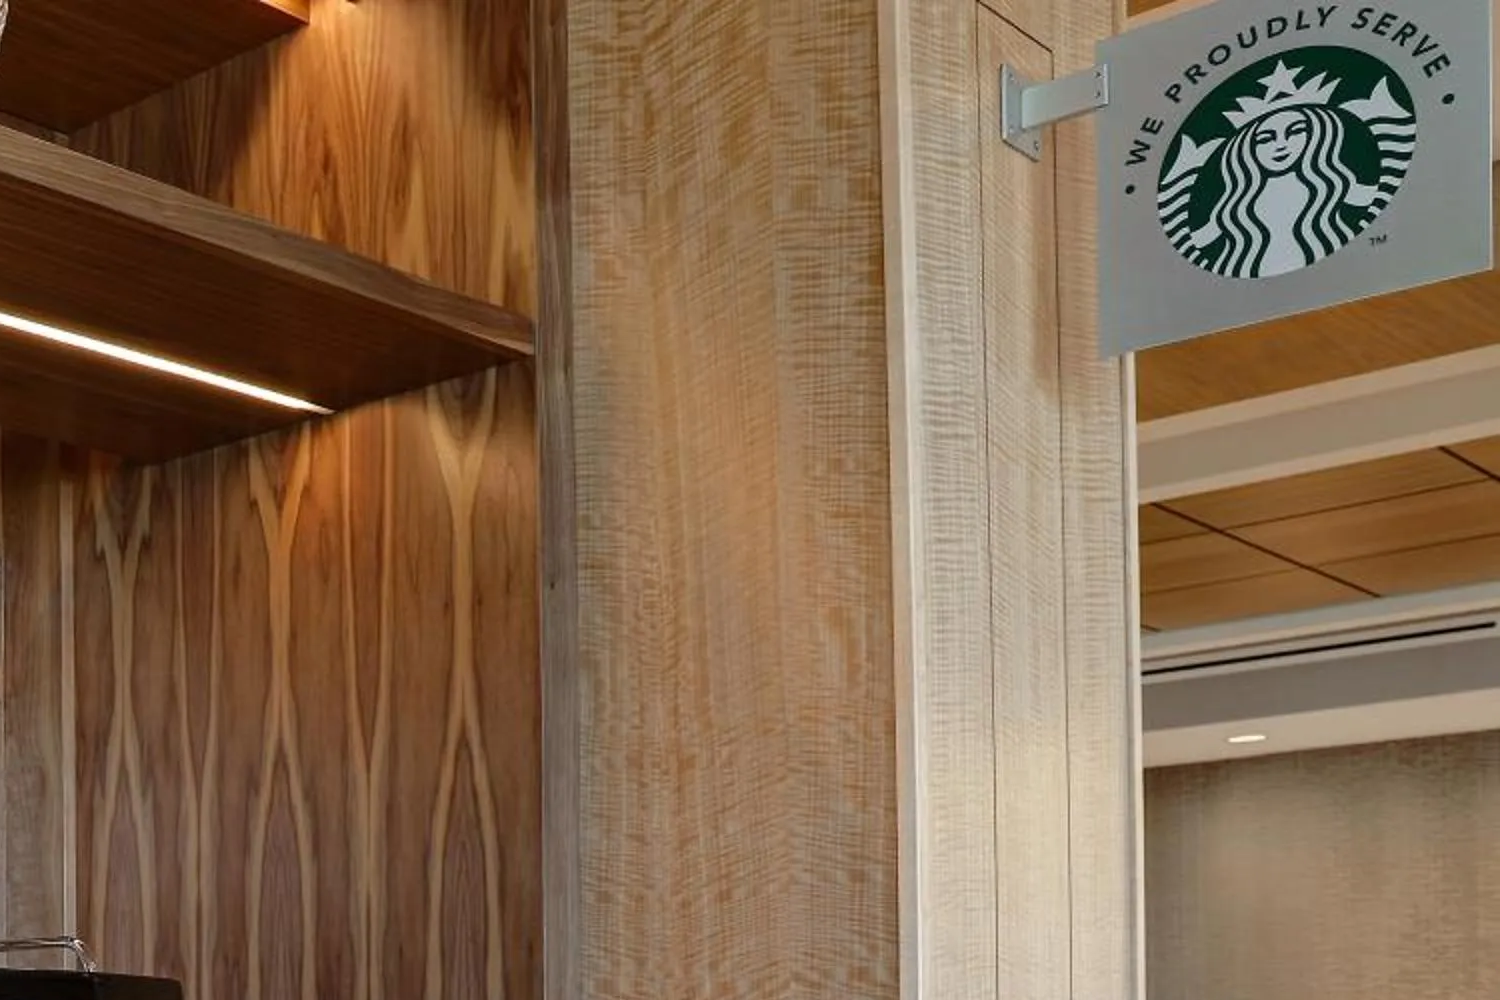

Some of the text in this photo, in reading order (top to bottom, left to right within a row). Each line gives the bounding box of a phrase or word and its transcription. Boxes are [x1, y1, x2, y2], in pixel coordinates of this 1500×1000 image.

[1125, 5, 1452, 166] WE PROUDLY SERVE
